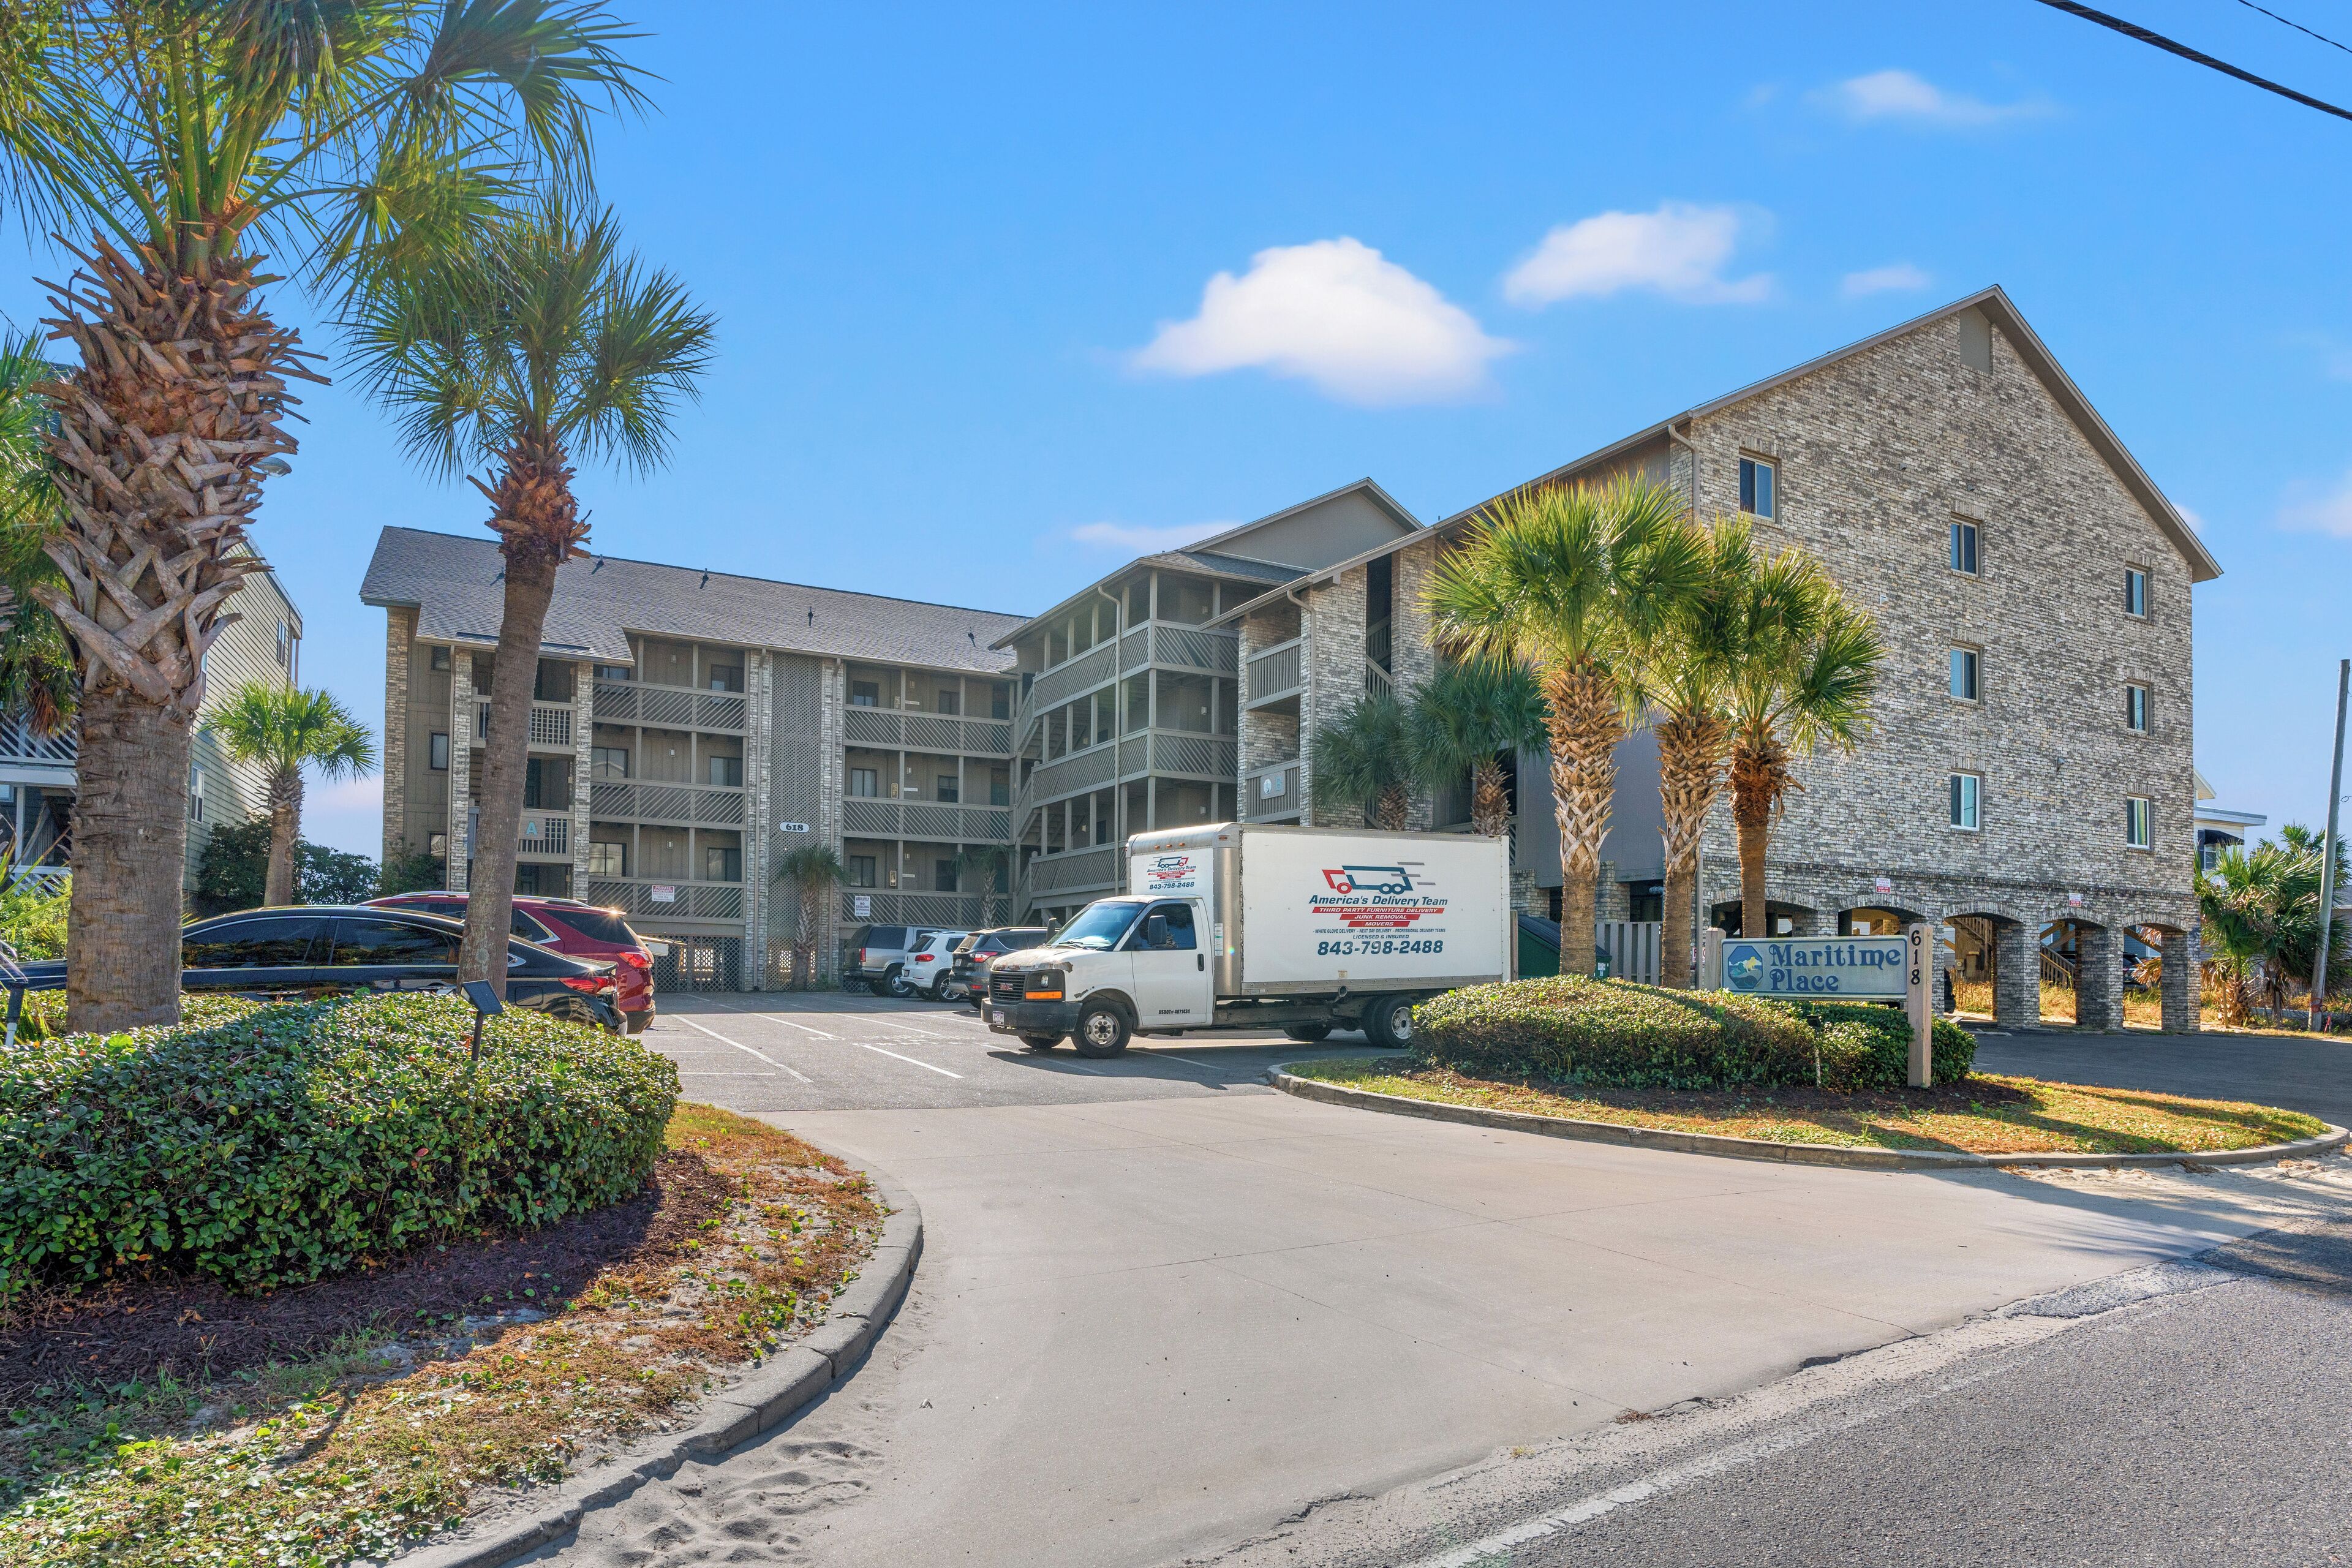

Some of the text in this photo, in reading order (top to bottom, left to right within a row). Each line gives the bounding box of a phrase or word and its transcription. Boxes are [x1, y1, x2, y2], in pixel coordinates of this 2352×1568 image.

[526, 821, 538, 835] A
[1308, 895, 1448, 907] America's Delivery Team
[1317, 940, 1444, 956] 843-798-2488
[1768, 943, 1901, 970] Maritime
[1769, 968, 1839, 991] Place
